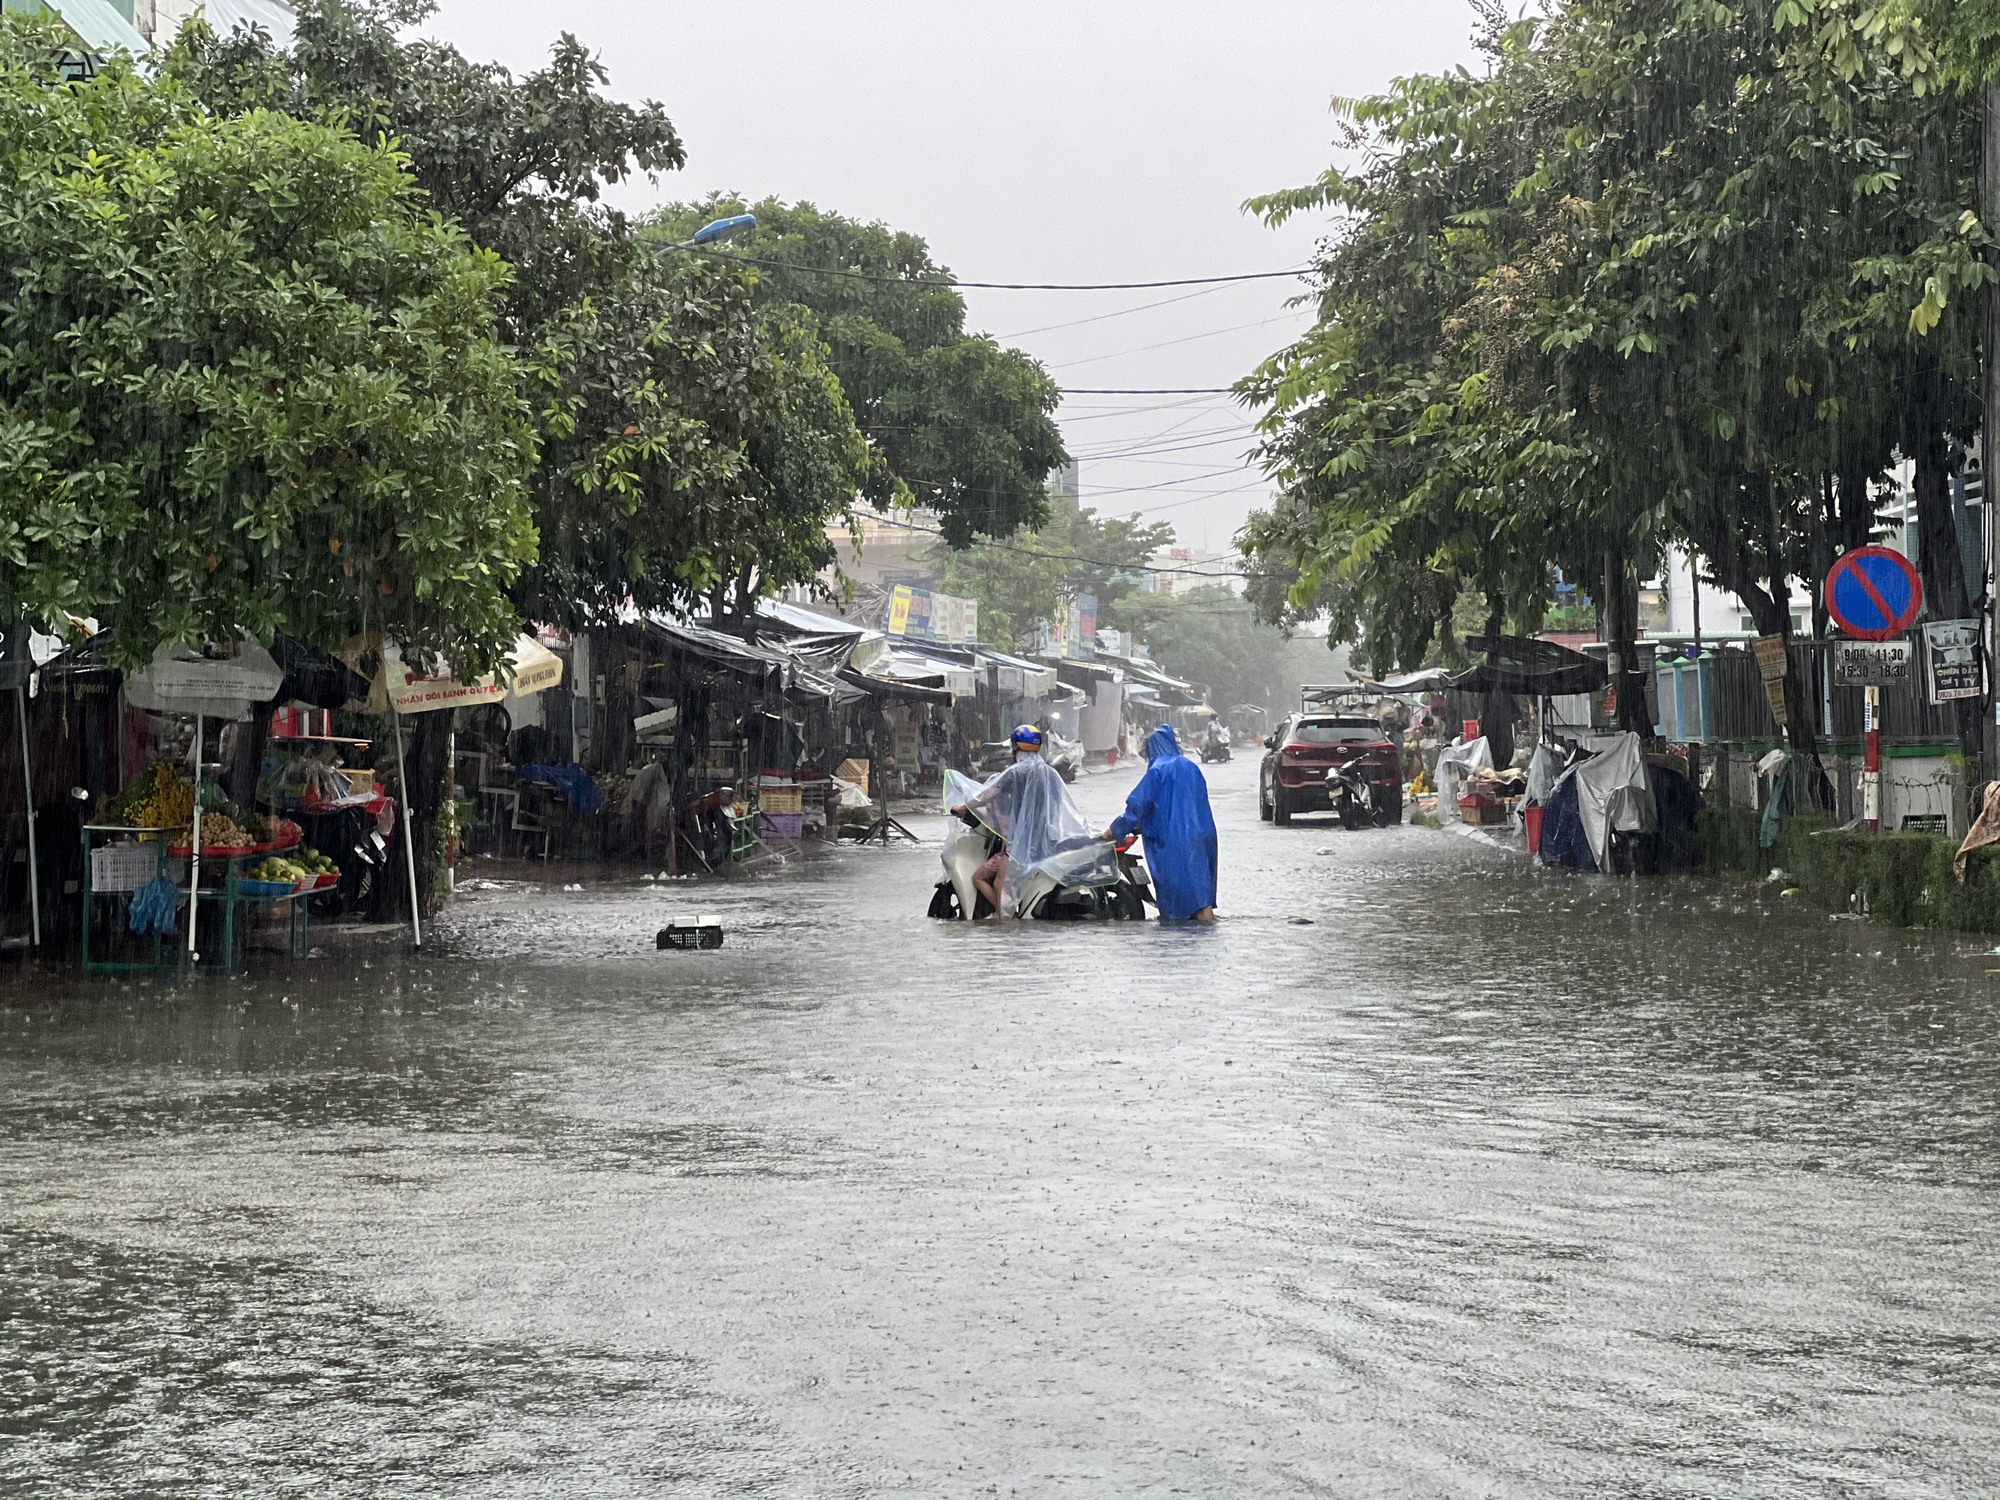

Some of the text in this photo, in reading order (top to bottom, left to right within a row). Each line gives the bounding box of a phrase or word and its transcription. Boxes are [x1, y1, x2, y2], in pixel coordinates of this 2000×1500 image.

[1844, 649, 1866, 660] 9:00
[1876, 649, 1903, 660] 11:30
[1841, 666, 1868, 677] 15:30
[1880, 666, 1906, 677] 18:30
